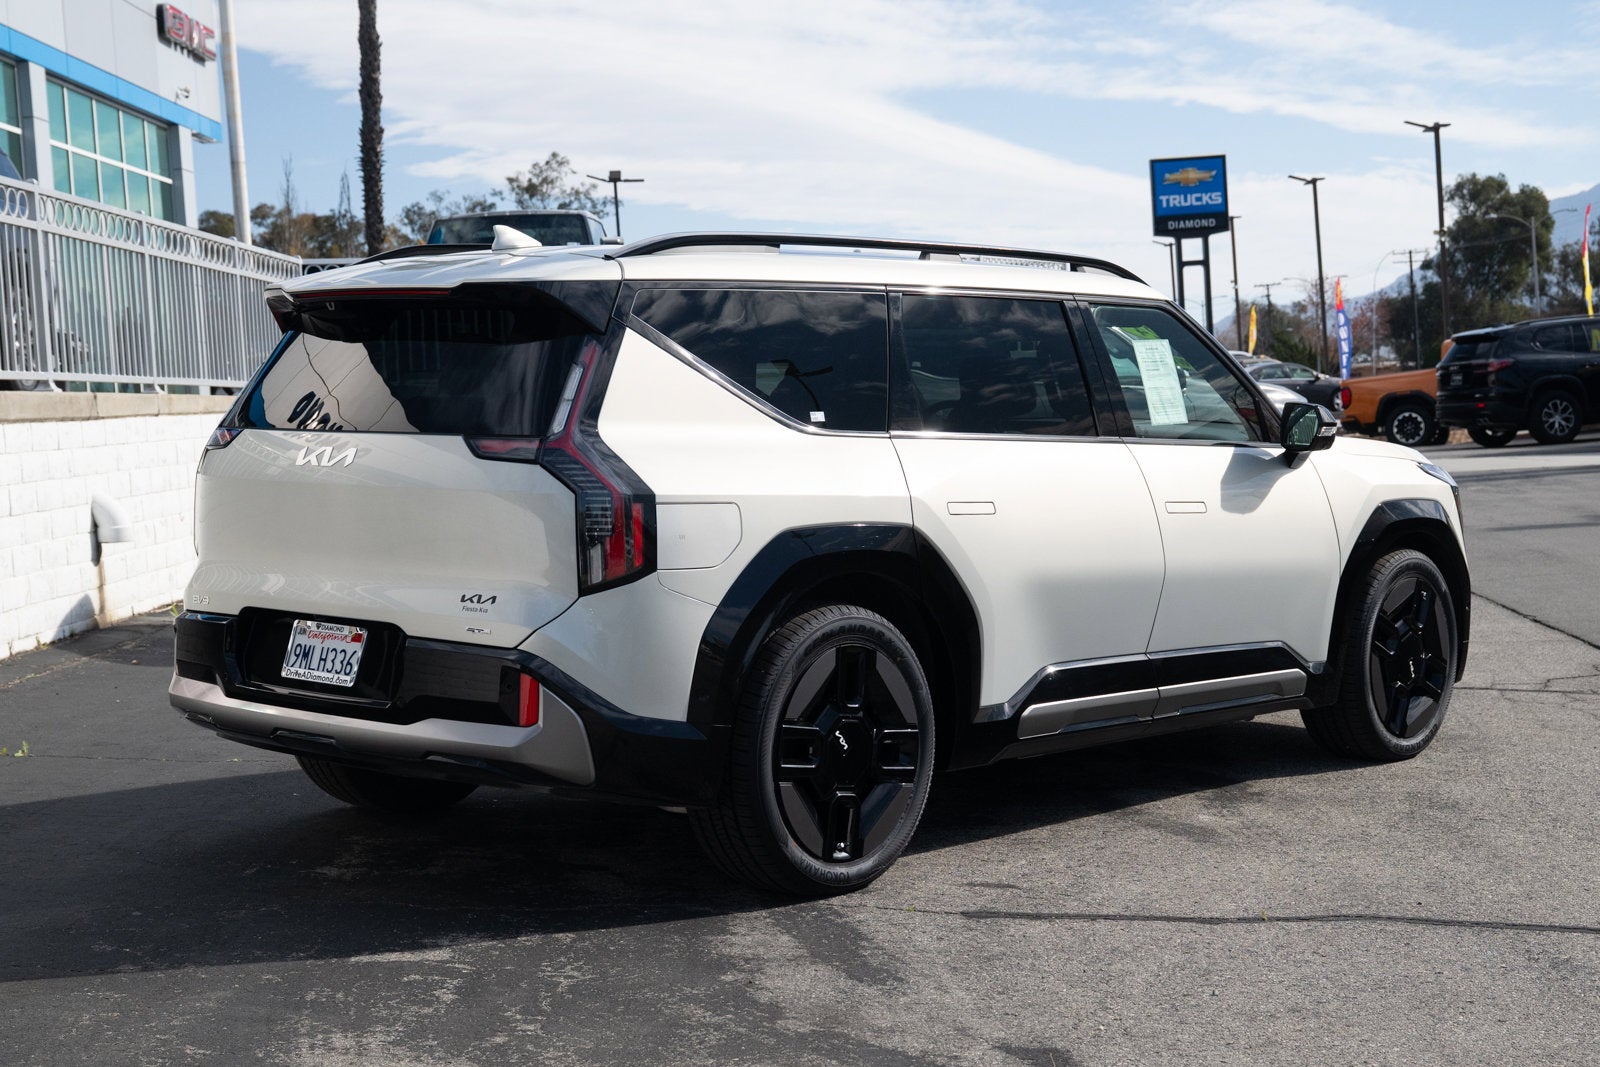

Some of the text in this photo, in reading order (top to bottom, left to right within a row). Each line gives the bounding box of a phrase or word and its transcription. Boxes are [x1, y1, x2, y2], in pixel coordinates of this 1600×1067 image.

[163, 4, 217, 58] GMC
[1158, 191, 1223, 208] TRUCKS
[1167, 218, 1216, 230] DIAMOND
[295, 446, 358, 468] KIA
[192, 595, 209, 605] EV9
[460, 593, 497, 605] KIA
[307, 630, 347, 644] California
[320, 624, 345, 633] DIAMOND
[290, 643, 356, 676] 9MLH336
[285, 669, 349, 686] DriveADiamond.com
[800, 856, 850, 881] YOKOHAMA
